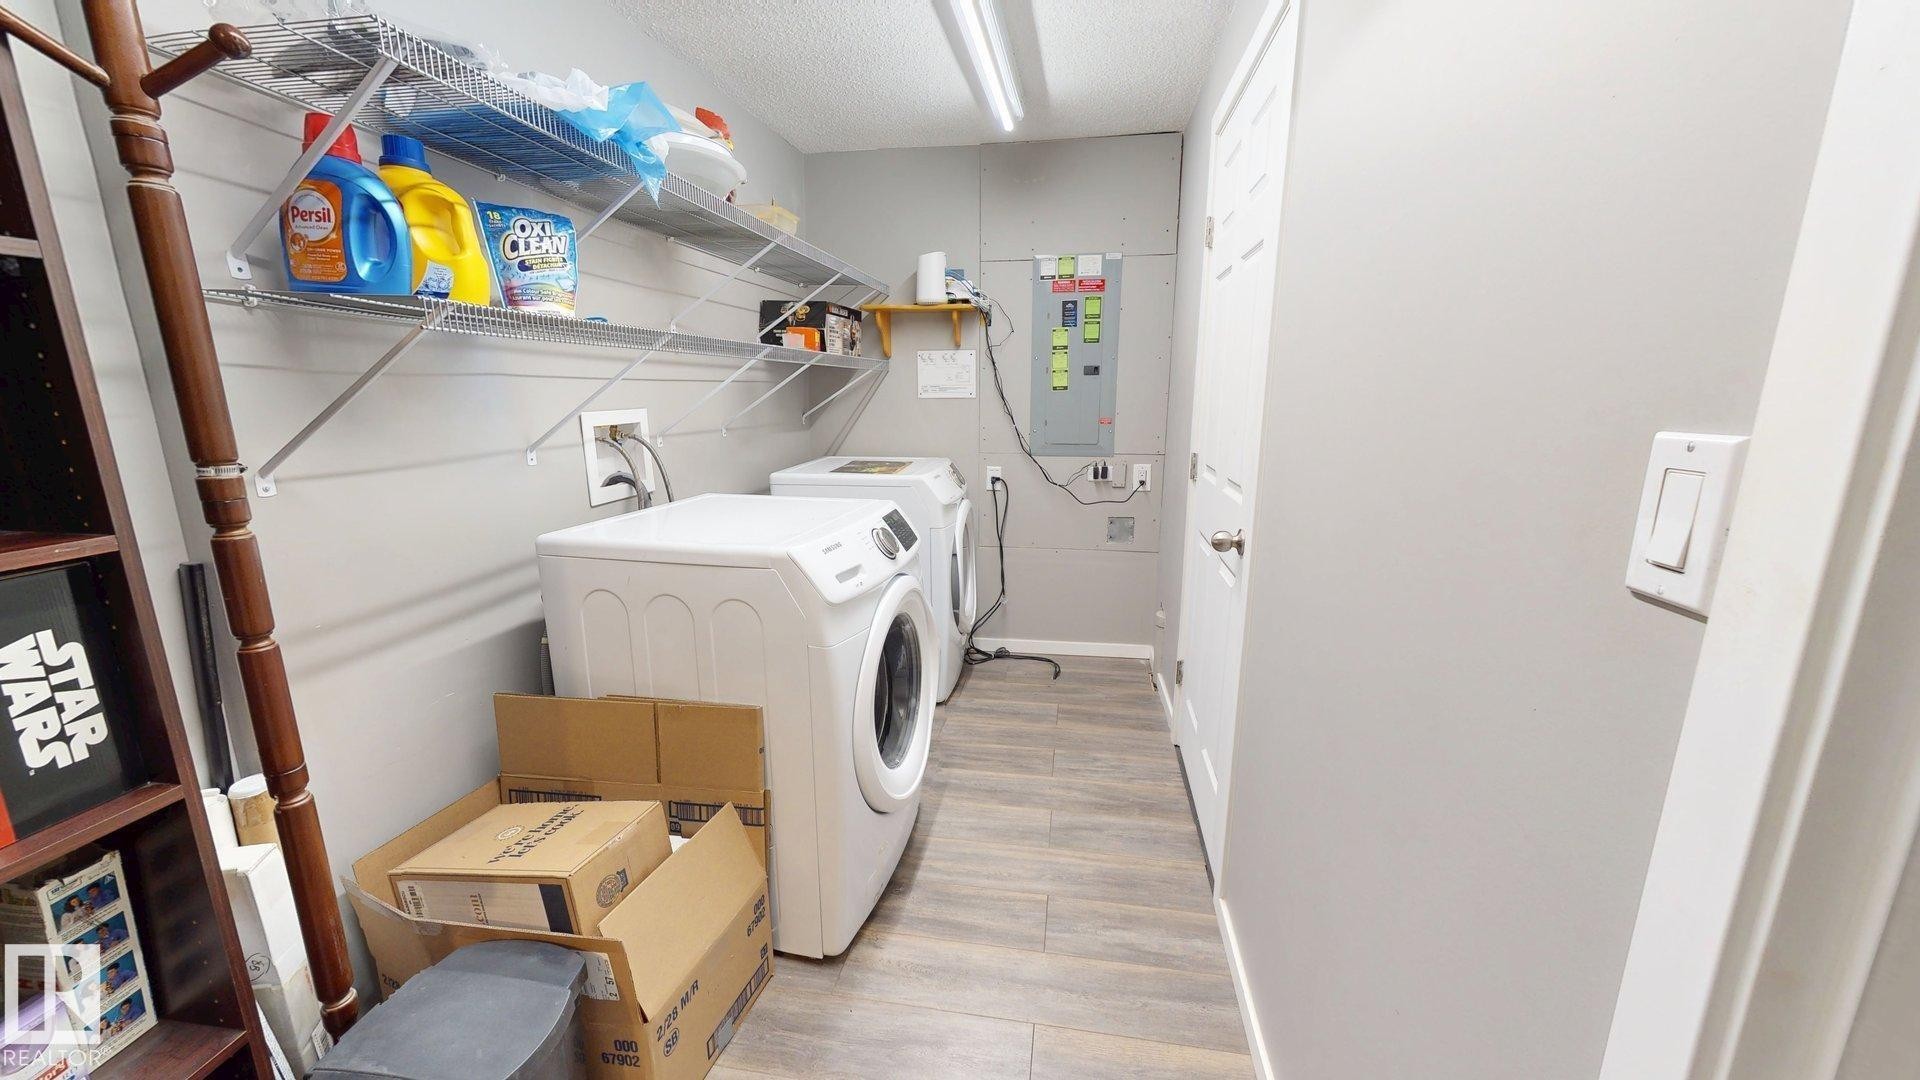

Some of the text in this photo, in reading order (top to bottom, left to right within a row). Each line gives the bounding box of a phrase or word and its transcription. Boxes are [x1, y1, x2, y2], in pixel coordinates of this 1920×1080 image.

[291, 206, 331, 223] Persil
[487, 211, 500, 220] 18
[513, 218, 552, 239] OXI
[503, 233, 567, 261] CLEAN
[822, 541, 842, 555] SAMSUNG
[0, 633, 74, 769] WARS
[35, 628, 109, 763] STAR
[656, 1006, 678, 1042] 2/28
[613, 1039, 639, 1053] 000
[665, 1030, 679, 1055] SB
[601, 1052, 641, 1068] 67902
